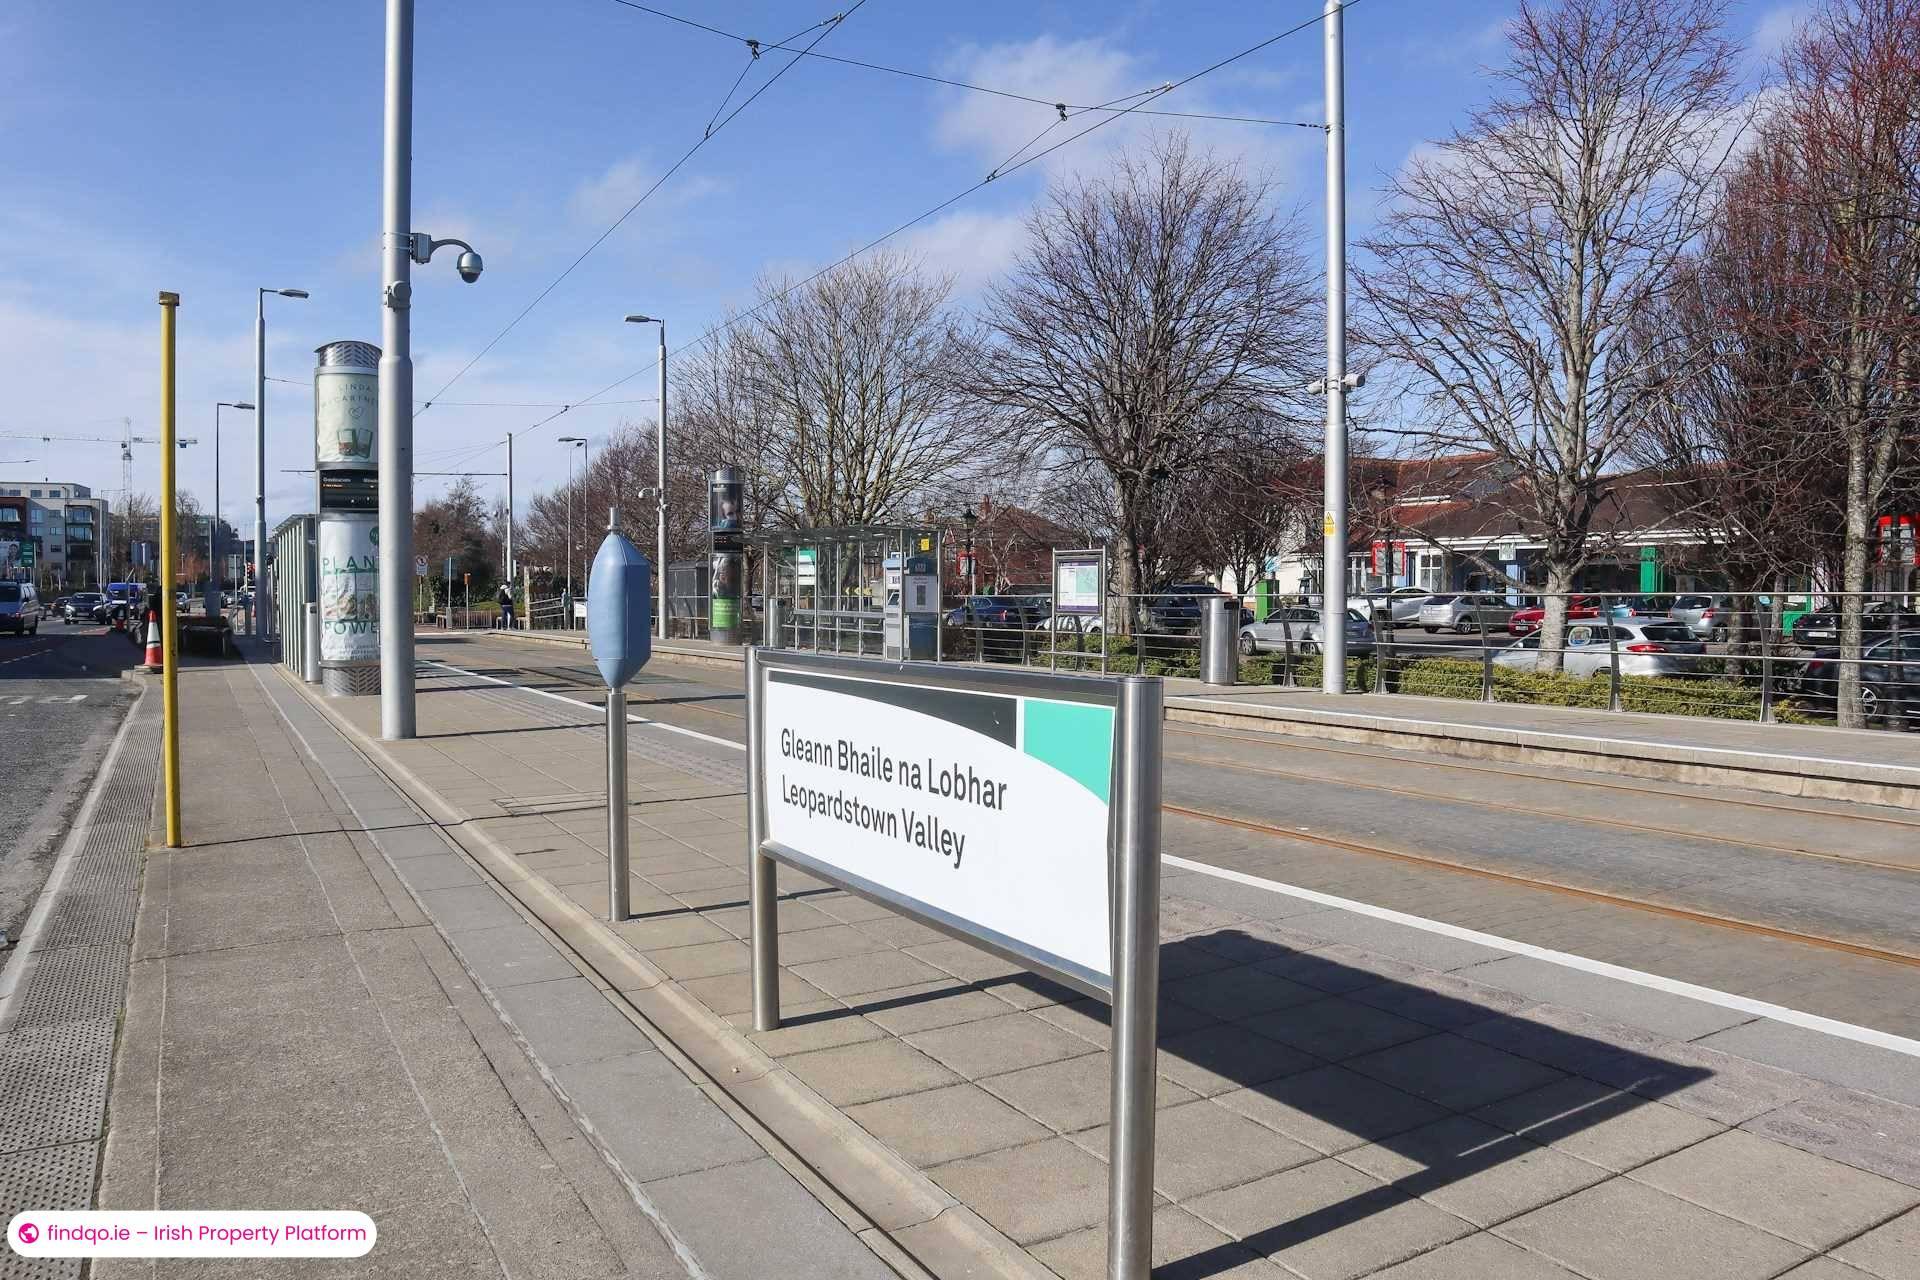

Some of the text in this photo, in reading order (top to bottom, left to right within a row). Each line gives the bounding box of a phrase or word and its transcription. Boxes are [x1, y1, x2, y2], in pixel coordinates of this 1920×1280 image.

[322, 555, 375, 569] PLAN
[324, 621, 377, 634] POWE
[781, 728, 1007, 811] Gleann Bhaile na Lobhar
[782, 774, 965, 870] Leopardstown Valley
